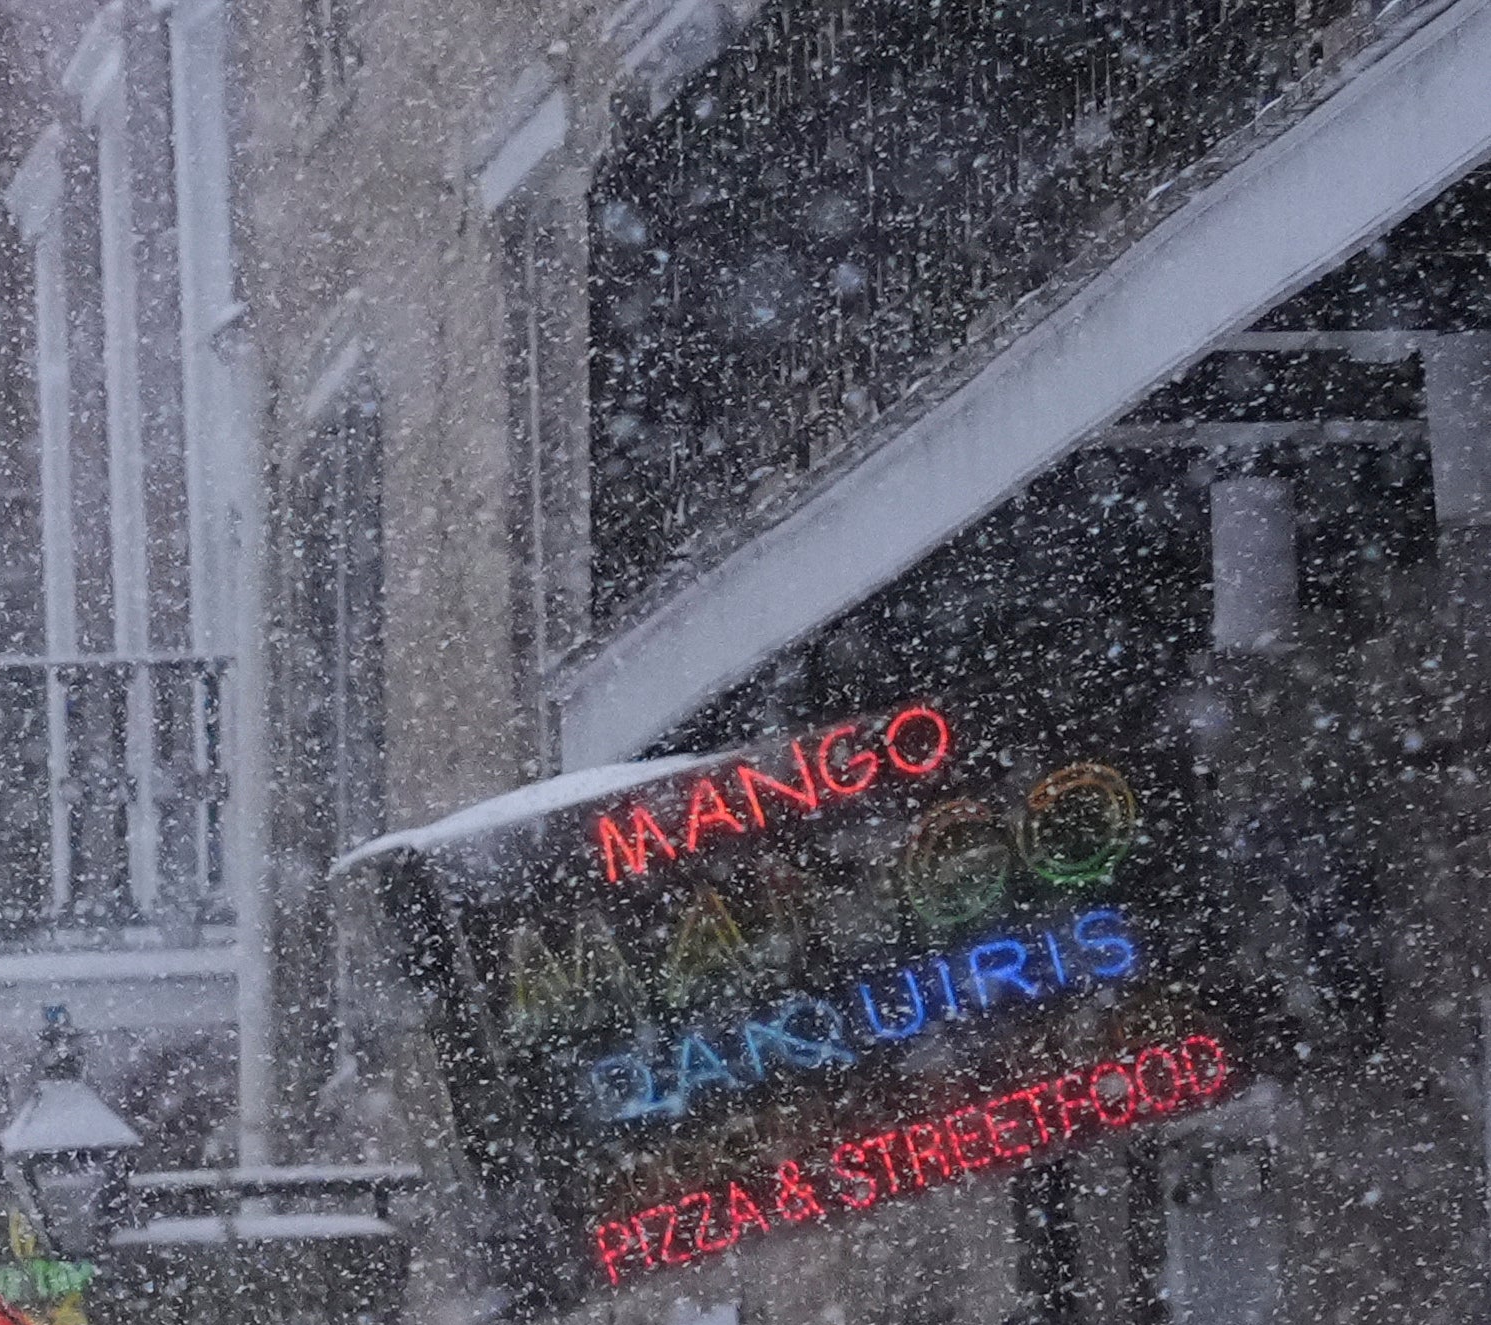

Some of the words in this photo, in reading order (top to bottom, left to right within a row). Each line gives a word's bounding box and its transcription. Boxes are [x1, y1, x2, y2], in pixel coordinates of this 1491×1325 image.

[597, 706, 950, 884] MANGO
[595, 1180, 772, 1286] PIZZA
[774, 1158, 827, 1223] &
